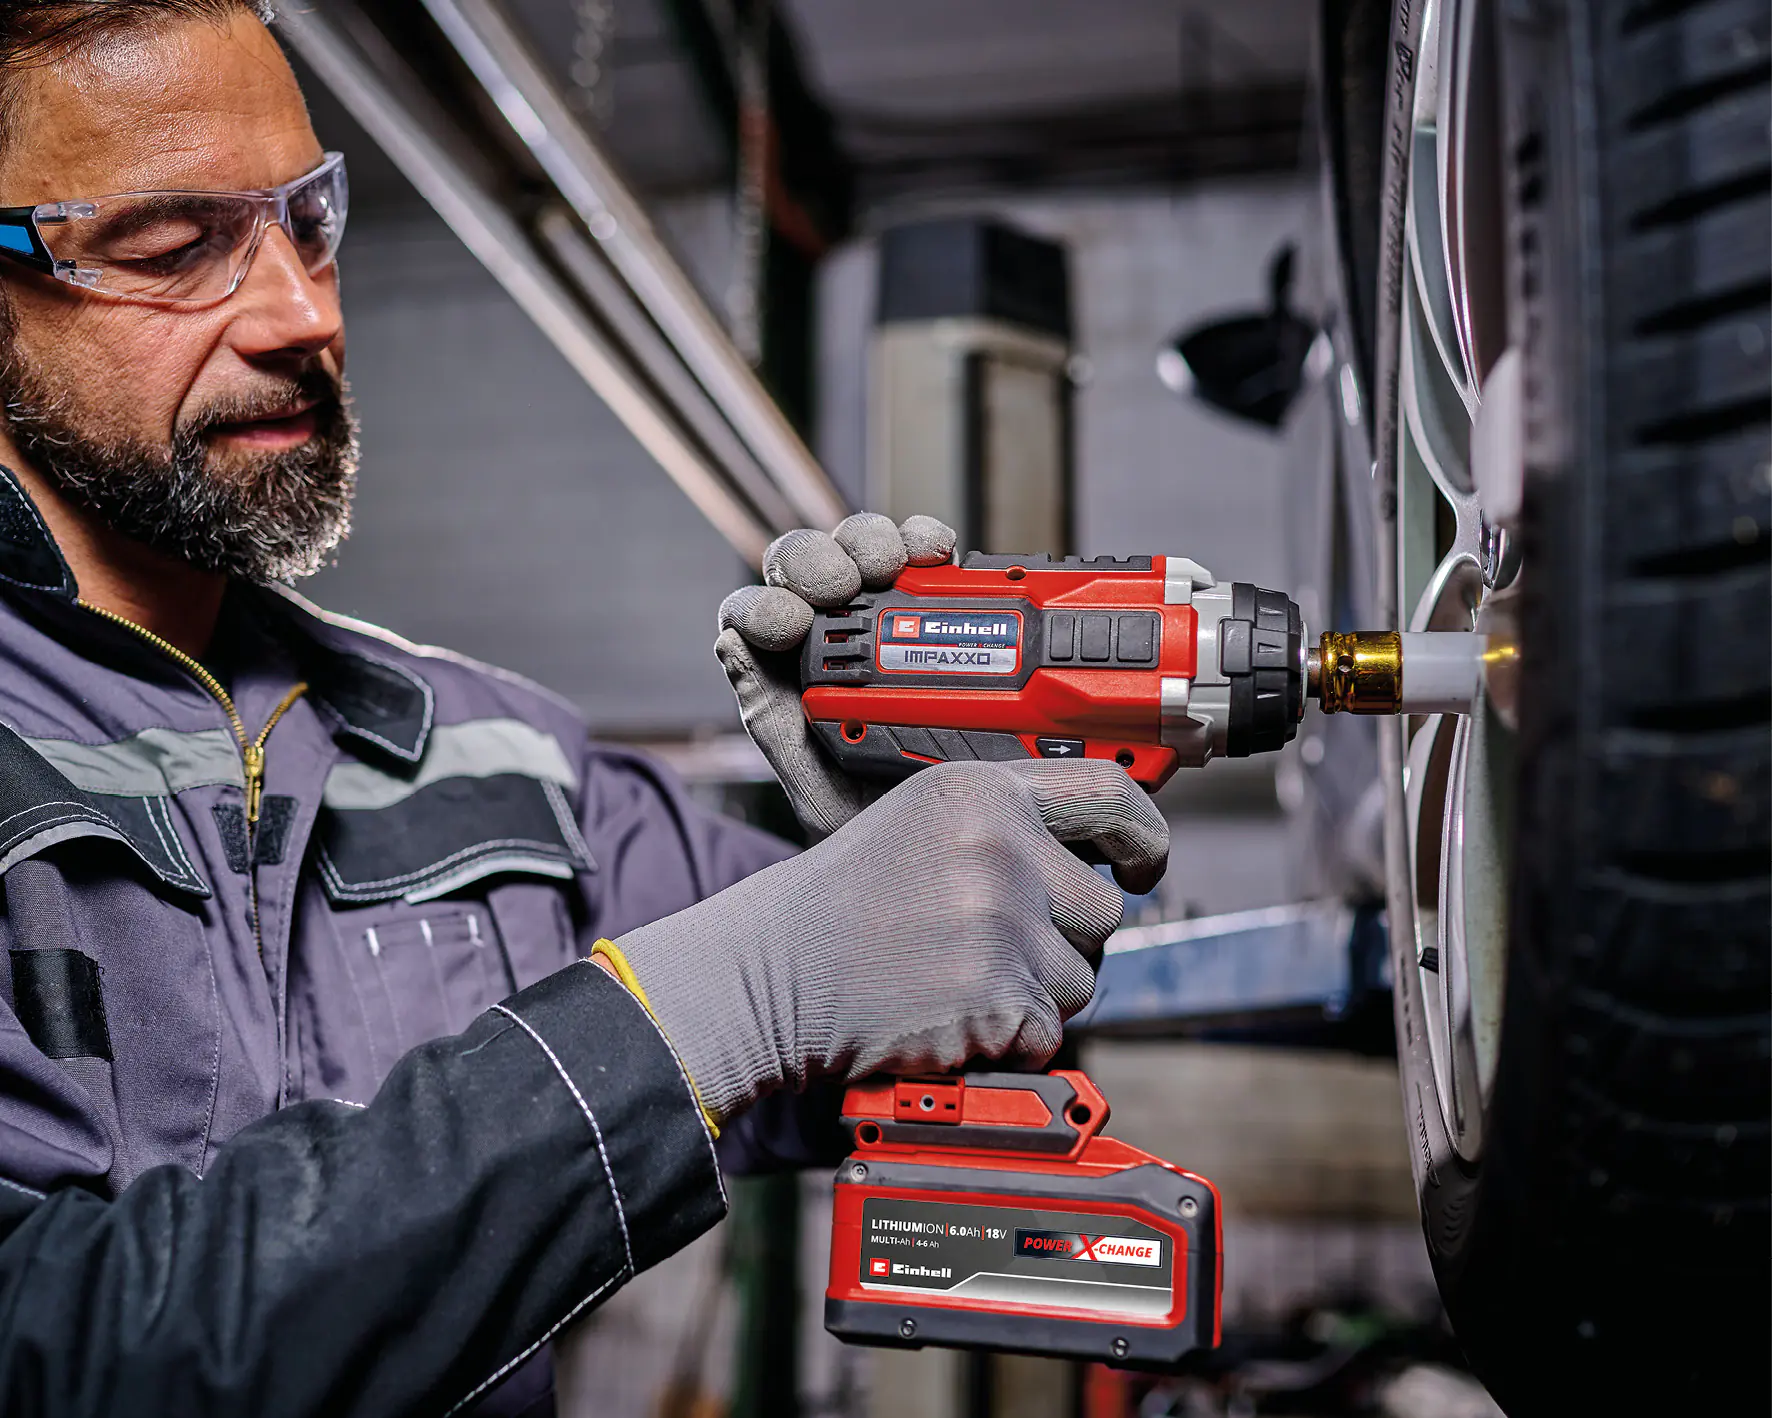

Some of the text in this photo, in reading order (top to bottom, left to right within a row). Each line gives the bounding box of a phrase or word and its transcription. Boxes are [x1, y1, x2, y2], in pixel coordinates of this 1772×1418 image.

[924, 621, 1007, 635] Einhell
[904, 650, 991, 665] IMPAXXO
[949, 1225, 981, 1238] 6.0Ah
[985, 1228, 1008, 1240] 18V
[871, 1235, 940, 1249] MULTI-Ah 4-6 Ah
[1023, 1236, 1073, 1253] POWER
[892, 1263, 952, 1279] Einhell
